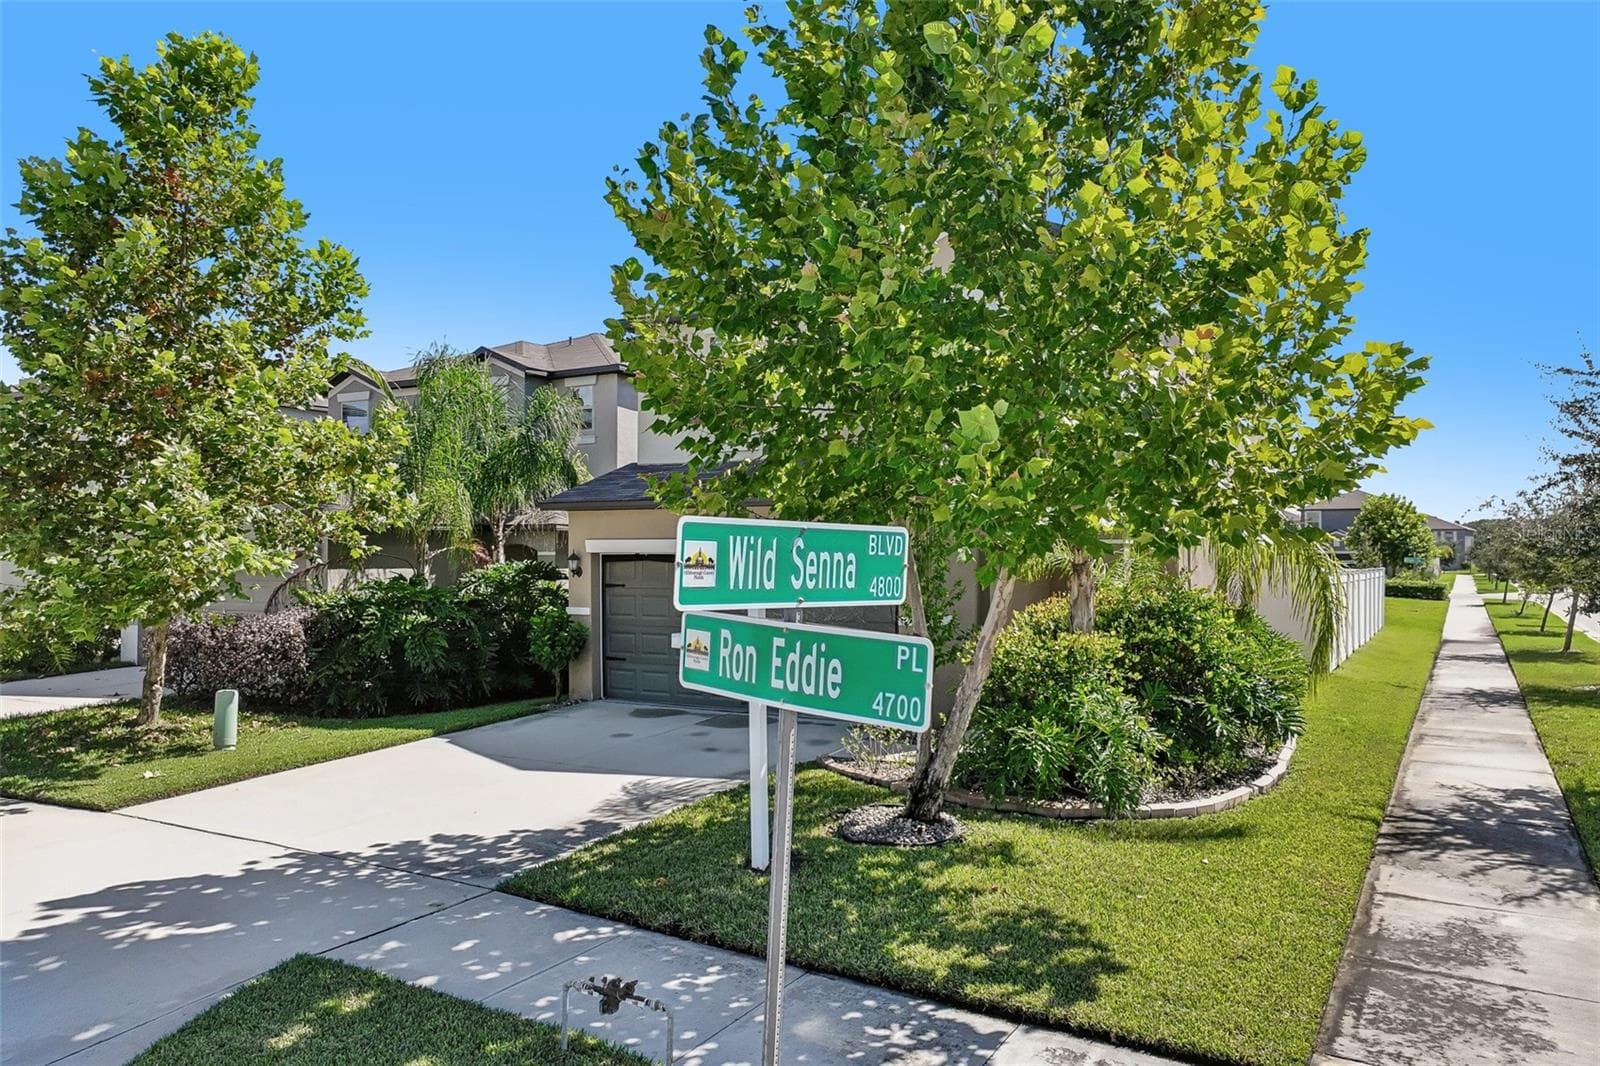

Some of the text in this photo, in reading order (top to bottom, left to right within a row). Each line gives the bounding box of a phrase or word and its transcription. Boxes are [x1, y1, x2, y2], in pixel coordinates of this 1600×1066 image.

[868, 534, 903, 556] BLVD
[729, 535, 856, 590] Wild Senna
[869, 576, 901, 597] 4800
[719, 629, 842, 699] Ron Eddie
[896, 645, 923, 673] PL
[872, 692, 921, 722] 4700
